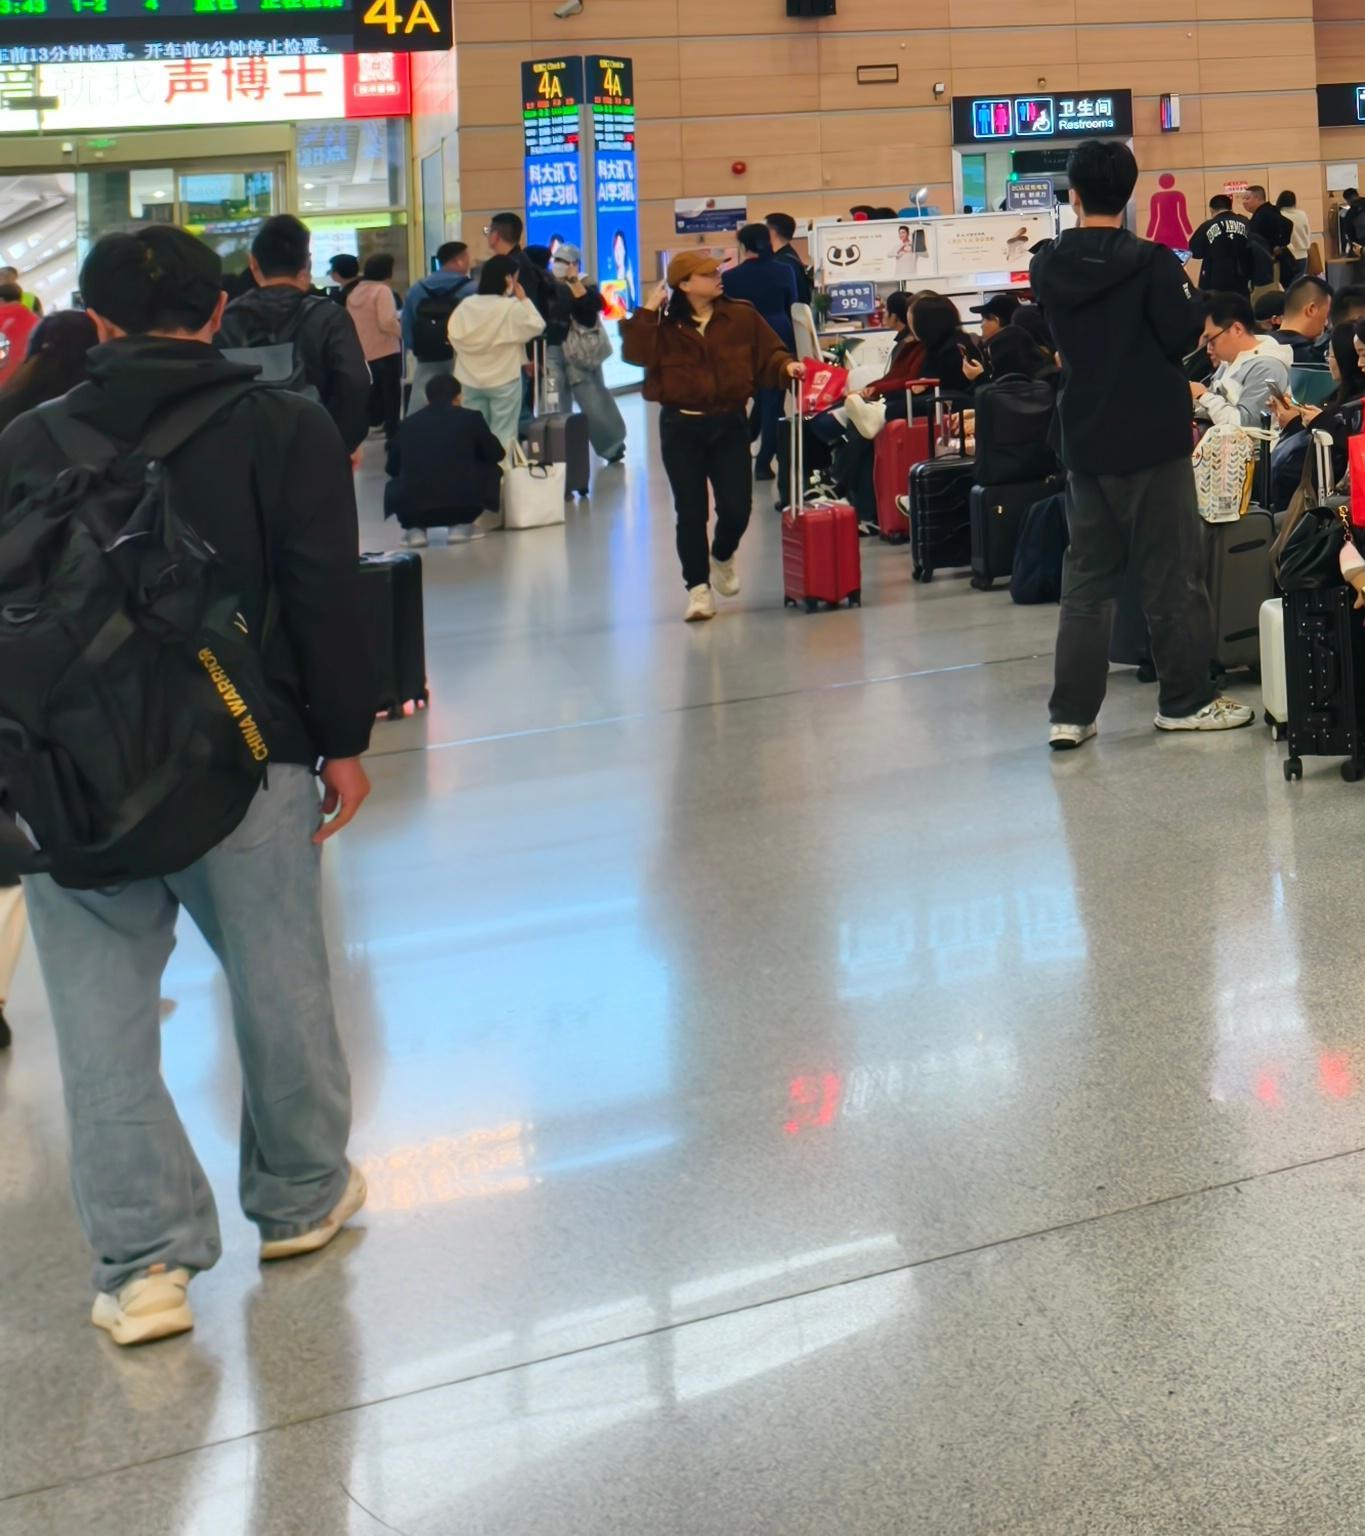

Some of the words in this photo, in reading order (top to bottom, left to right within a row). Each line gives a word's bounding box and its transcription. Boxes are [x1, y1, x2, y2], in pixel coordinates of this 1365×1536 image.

[538, 71, 562, 99] 4A
[603, 68, 622, 96] 4A
[1058, 98, 1113, 117] 卫生间
[1058, 118, 1114, 131] Restrooms
[198, 647, 248, 717] WARRIOR
[239, 714, 268, 761] CHINA
